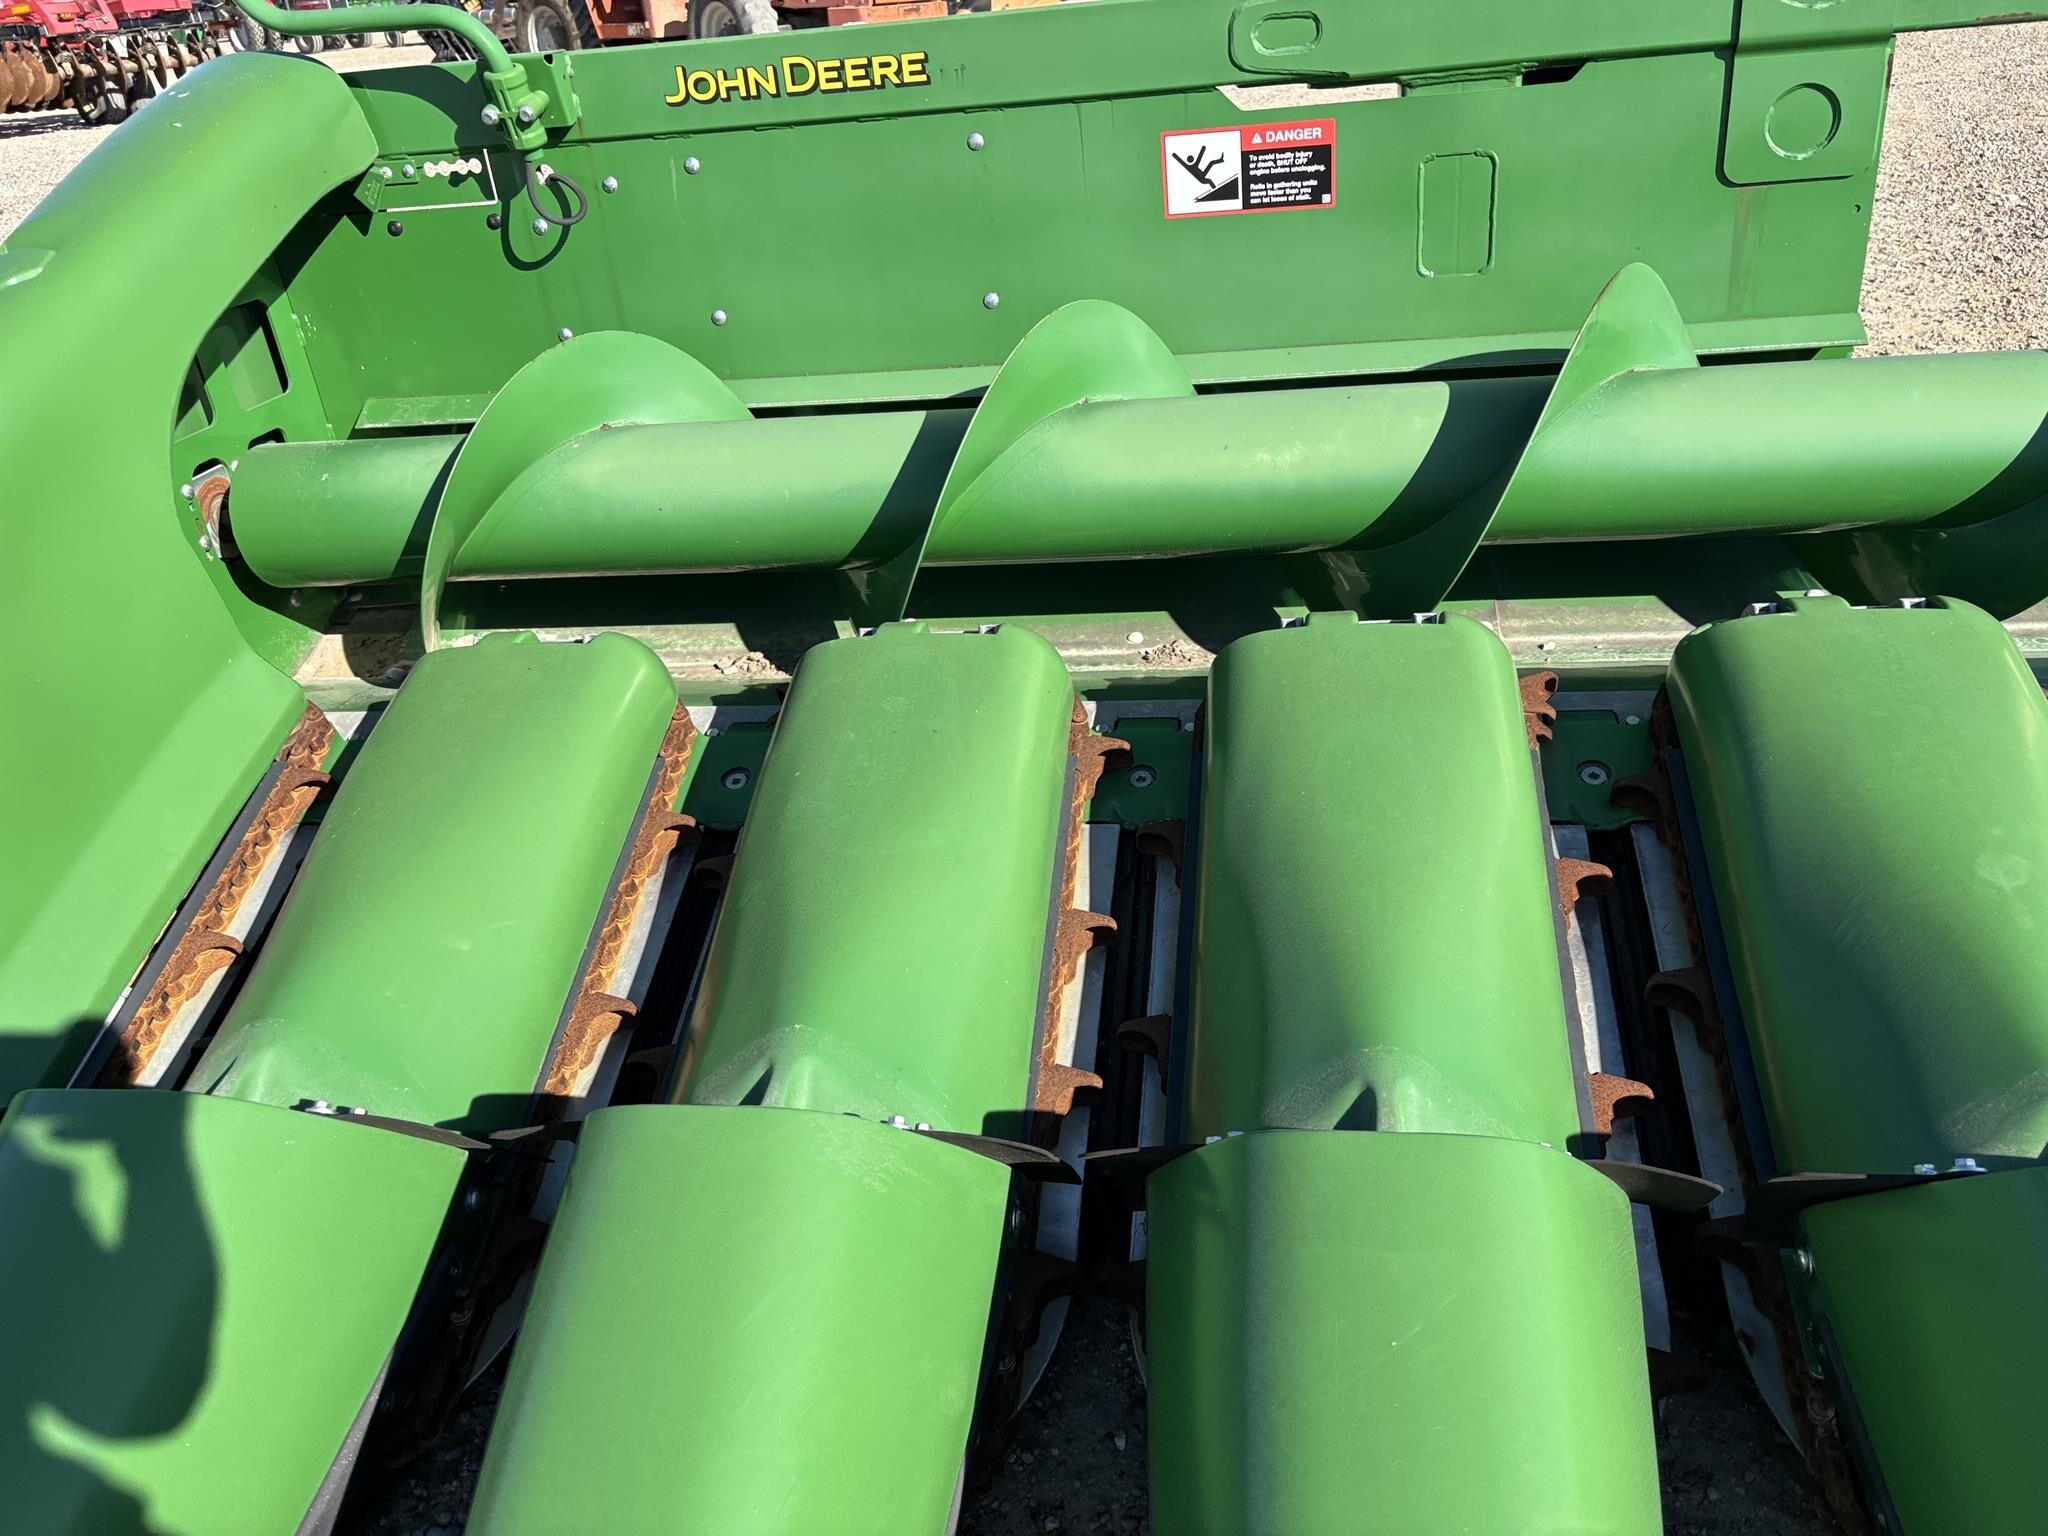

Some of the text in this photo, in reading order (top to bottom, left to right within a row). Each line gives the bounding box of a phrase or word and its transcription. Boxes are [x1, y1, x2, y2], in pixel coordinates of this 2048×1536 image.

[665, 51, 930, 106] JOHN DEERE
[1265, 127, 1322, 143] DANGER
[1258, 153, 1275, 161] avoid
[1276, 152, 1294, 160] bodily
[1295, 150, 1313, 159] injury
[1276, 158, 1294, 167] SHUT
[1294, 157, 1308, 165] OFF
[1249, 163, 1326, 176] engine before unclogging.
[1273, 180, 1302, 189] gathering
[1299, 187, 1312, 195] you
